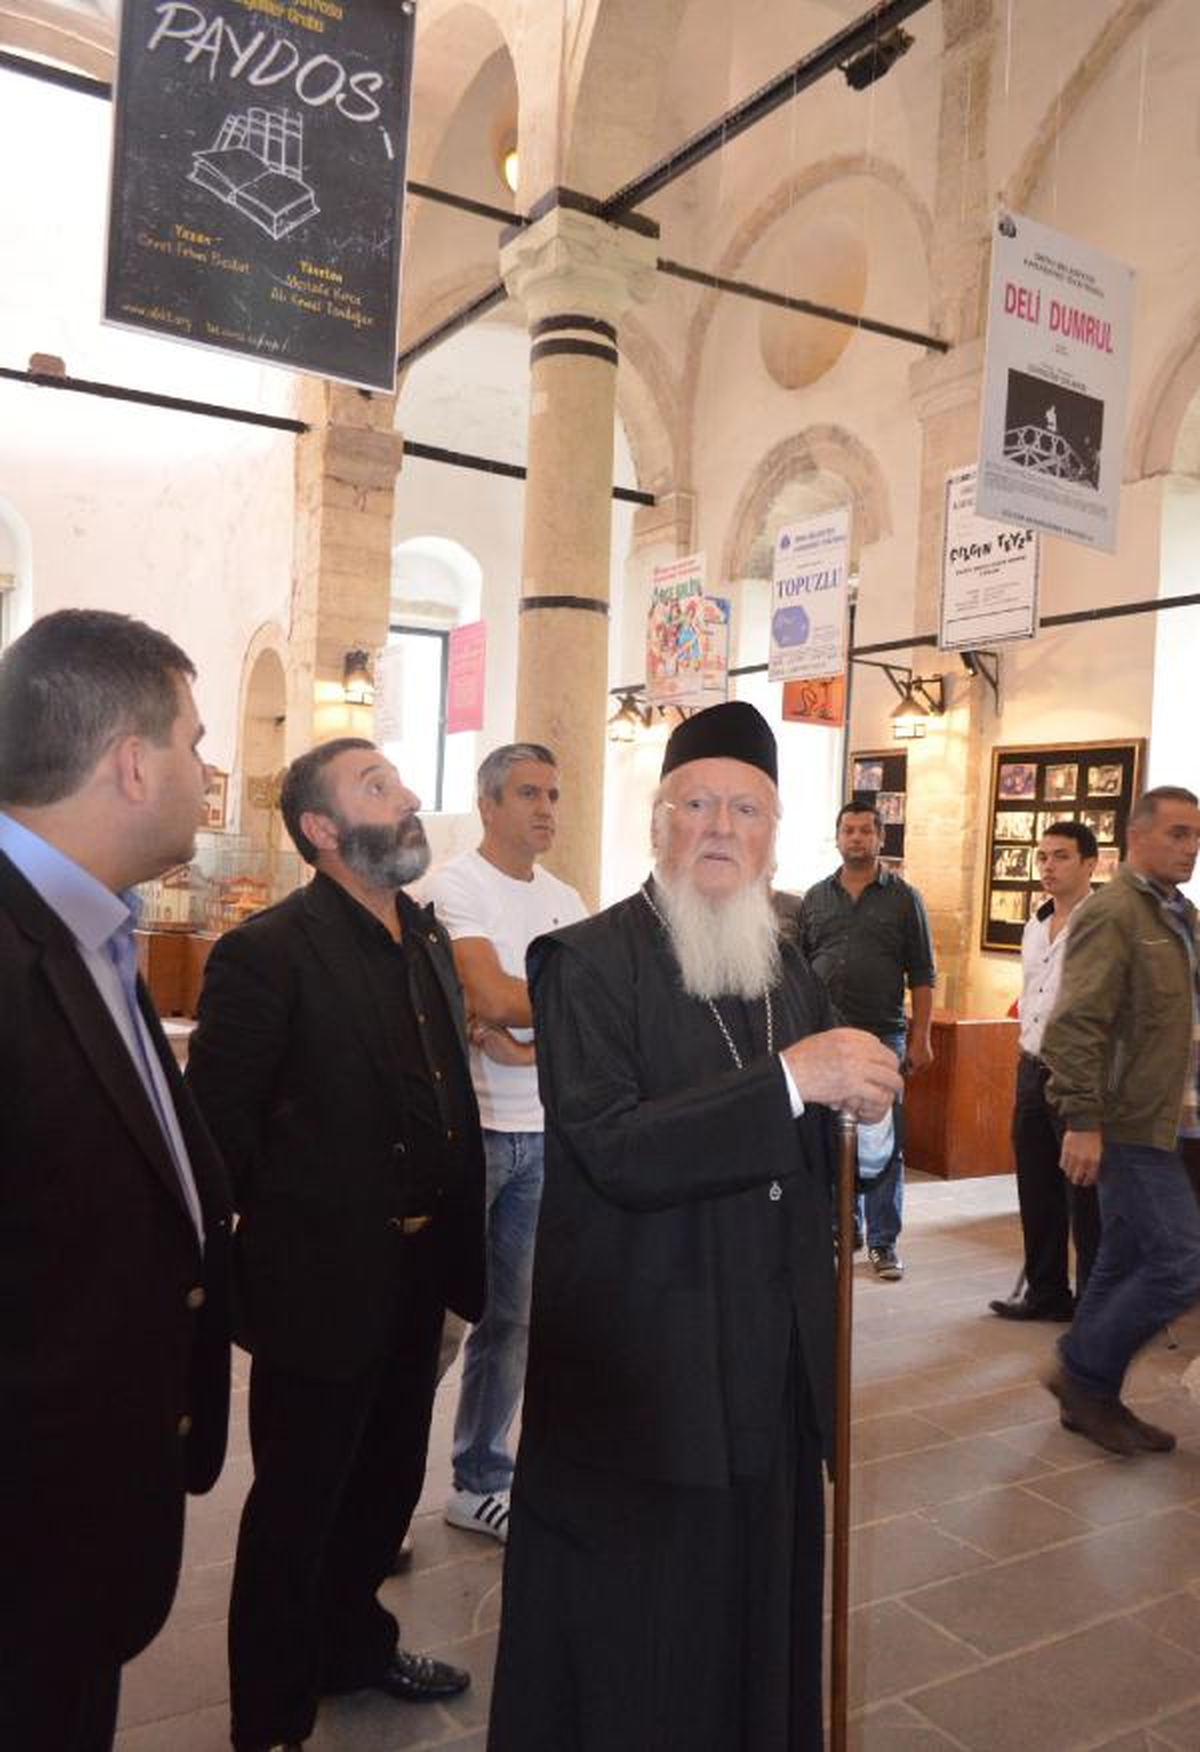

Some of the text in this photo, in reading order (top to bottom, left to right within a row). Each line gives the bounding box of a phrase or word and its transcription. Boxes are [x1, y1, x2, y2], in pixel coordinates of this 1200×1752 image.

[148, 2, 383, 121] PAYDOS
[1003, 282, 1114, 354] DELİ DUMRUL
[775, 566, 843, 600] TOPUZLU
